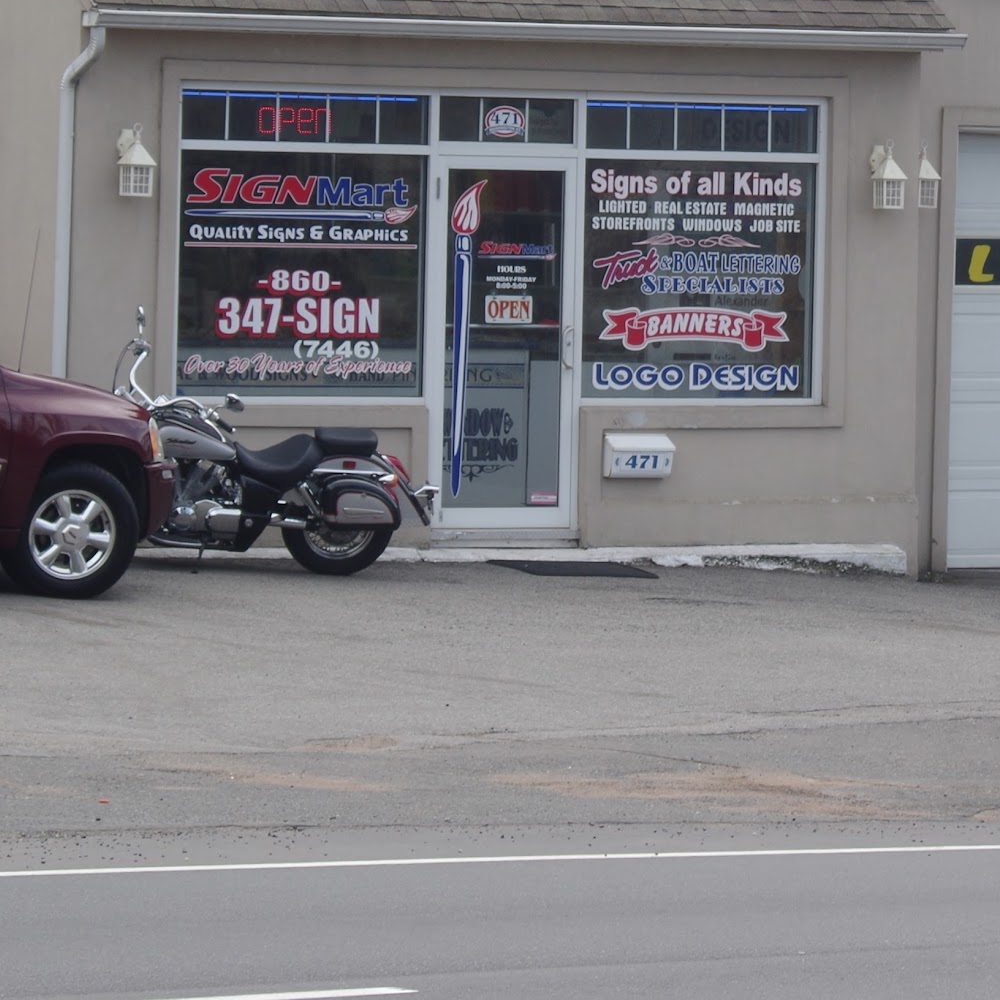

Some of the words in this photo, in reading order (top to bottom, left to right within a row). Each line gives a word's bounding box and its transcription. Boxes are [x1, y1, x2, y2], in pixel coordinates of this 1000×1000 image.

[491, 112, 518, 125] 471
[186, 168, 409, 206] SIGNMart
[591, 169, 658, 199] Signs
[665, 171, 692, 195] of
[697, 171, 725, 196] all
[733, 172, 802, 197] Kinds
[599, 200, 647, 214] LIGHTED
[654, 201, 684, 215] REAL
[685, 202, 727, 216] ESTATE
[734, 203, 794, 217] MAGNETIC
[309, 226, 323, 240] &
[592, 216, 675, 231] STOREFRONTS
[682, 218, 742, 232] WINDOWS
[749, 219, 774, 233] JOB
[775, 219, 801, 233] SITE
[478, 241, 554, 255] SIGNMart
[497, 265, 527, 273] HOURS
[593, 247, 660, 290] Truck
[660, 256, 672, 270] &
[671, 251, 719, 275] BOAT
[721, 253, 801, 275] LETTERING
[641, 274, 785, 296] SPECIALISTS
[217, 297, 380, 338] 347-SIGN
[487, 300, 531, 319] OPEN
[646, 312, 744, 338] BANNERS
[293, 340, 379, 359] (7446)
[184, 354, 225, 374] Over
[226, 357, 251, 374] 30
[250, 353, 303, 380] Years
[305, 356, 324, 377] of
[324, 356, 412, 379] Experience
[592, 362, 684, 391] LOGO
[689, 362, 799, 391] DESIGN
[625, 455, 658, 469] 471
